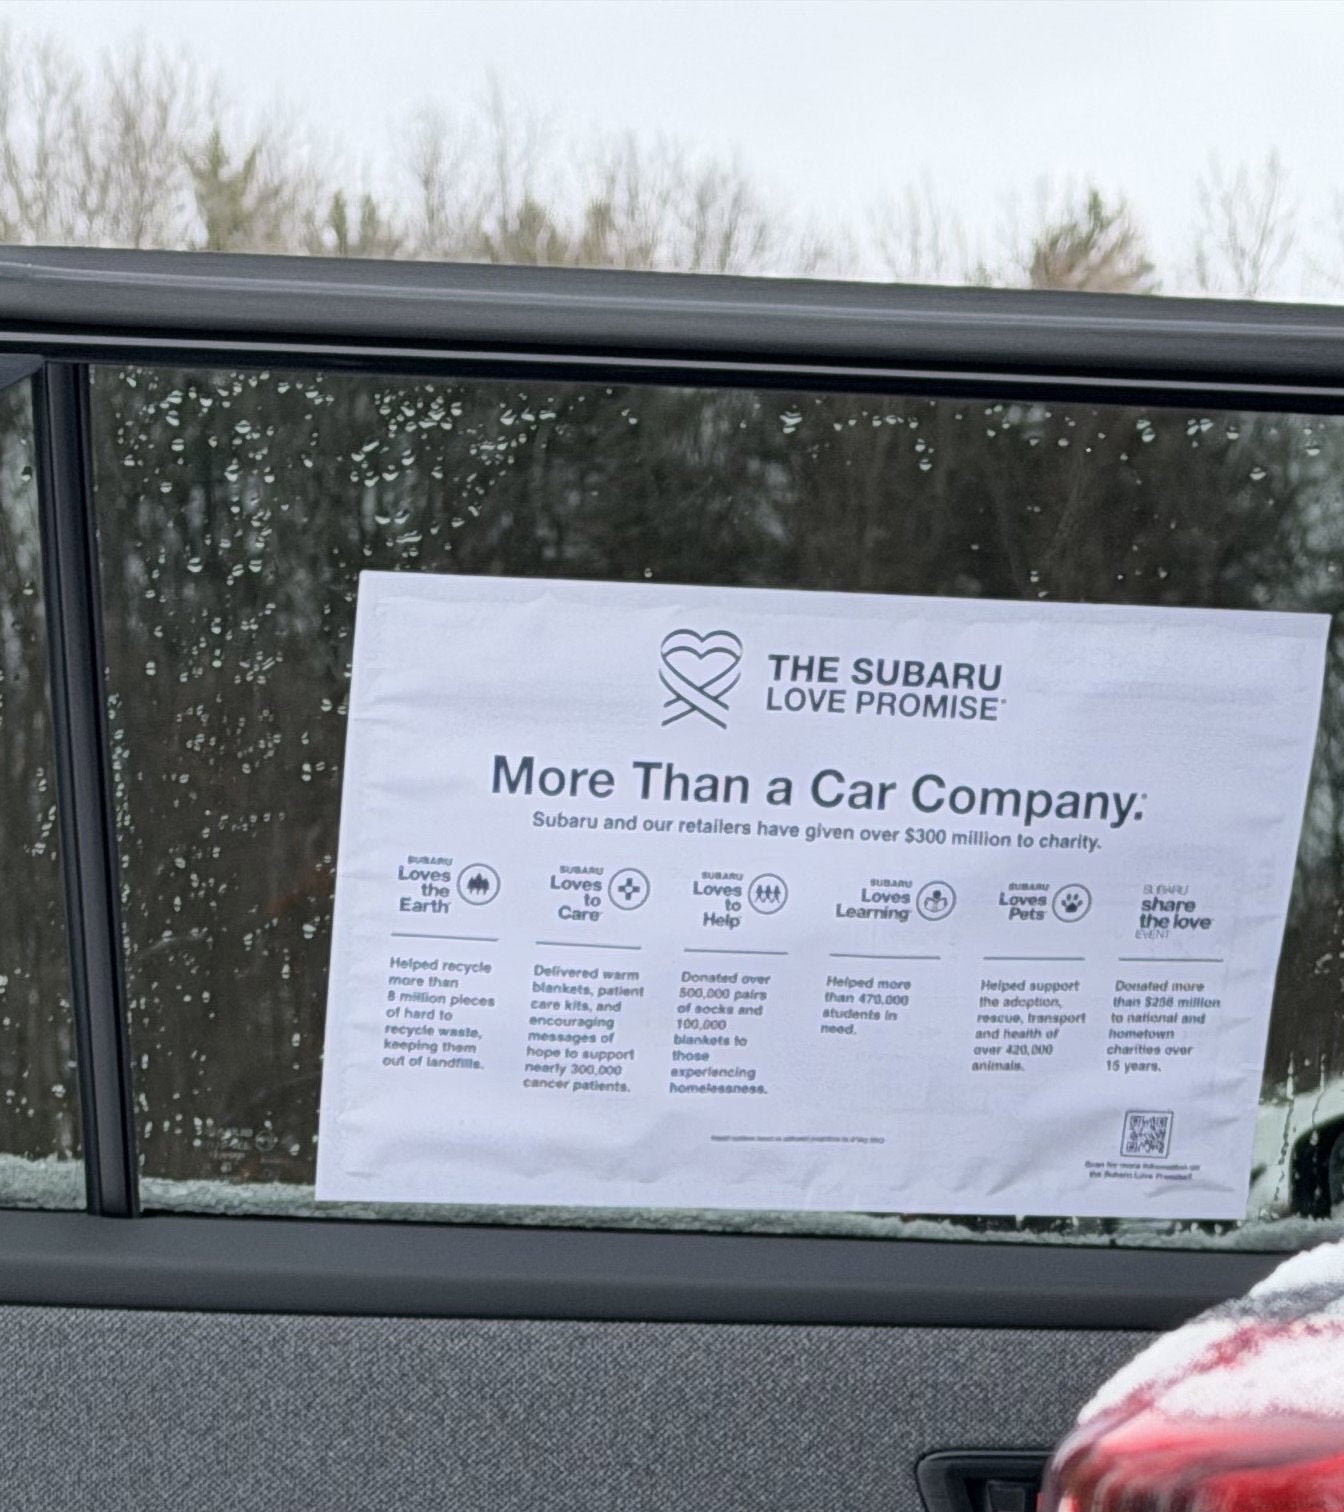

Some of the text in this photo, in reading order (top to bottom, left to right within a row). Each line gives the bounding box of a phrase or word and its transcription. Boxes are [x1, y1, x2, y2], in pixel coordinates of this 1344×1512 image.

[768, 653, 1002, 691] THE SUBARU
[766, 686, 846, 713] LOVE
[491, 755, 615, 800] More
[633, 761, 749, 804] Than
[766, 774, 792, 806] a
[811, 768, 896, 811] Car
[532, 811, 1101, 852] Subaru and our retailers have given over $300 million to charity.
[408, 856, 453, 866] SUBARU
[398, 866, 451, 882] Loves
[560, 865, 604, 875] SUBARU
[702, 872, 743, 881] SUBARU
[551, 875, 602, 891] Loves
[693, 881, 742, 896] Loves
[870, 879, 912, 888] SUBARU
[1008, 882, 1050, 891] SUBARU
[422, 883, 450, 897] the
[861, 888, 910, 903] Loves
[400, 897, 449, 913] Earth
[584, 894, 601, 907] to
[725, 899, 741, 911] to
[999, 892, 1047, 906] Loves
[1142, 898, 1196, 912] share
[558, 906, 599, 922] Care
[836, 903, 909, 922] Learning
[1008, 908, 1045, 920] Pets
[703, 912, 740, 929] Help
[1140, 914, 1212, 930] the love
[390, 957, 492, 975] Helped recycle
[534, 965, 639, 981] Delivered warm
[681, 971, 770, 985] Donated over
[389, 976, 458, 988] more than
[826, 976, 911, 990] Helped more
[981, 980, 1080, 993] Helped support
[1115, 980, 1205, 992] Donated more
[533, 982, 644, 998] blankets, patient
[734, 989, 767, 1002] pairs
[388, 991, 495, 1008] 8 million pieces
[825, 992, 854, 1004] than
[979, 996, 1062, 1009] the adoption,
[1113, 998, 1141, 1008] than
[1178, 998, 1220, 1008] million
[531, 1000, 622, 1012] care kits, and
[677, 1004, 763, 1016] of socks and
[386, 1007, 453, 1021] of hard to
[822, 1009, 897, 1021] students in
[977, 1013, 1086, 1025] rescue, transport
[1111, 1013, 1206, 1024] to national and
[530, 1016, 614, 1029] encouraging
[821, 1023, 856, 1035] need.
[385, 1024, 482, 1040] recycle waste,
[528, 1032, 615, 1044] messages of
[976, 1029, 1060, 1039] and health of
[1108, 1029, 1174, 1039] hometown
[384, 1039, 476, 1054] keeping them
[674, 1035, 747, 1046] blankets to
[527, 1047, 634, 1061] hope to support
[672, 1050, 709, 1061] those
[974, 1046, 1002, 1055] over
[1107, 1045, 1194, 1056] charities over
[383, 1056, 484, 1069] out of landfills.
[972, 1061, 1025, 1072] animals.
[1124, 1061, 1161, 1074] years.
[525, 1063, 566, 1077] nearly
[671, 1067, 756, 1080] experiencing
[523, 1079, 630, 1094] cancer patients.
[669, 1083, 768, 1094] homelessness.
